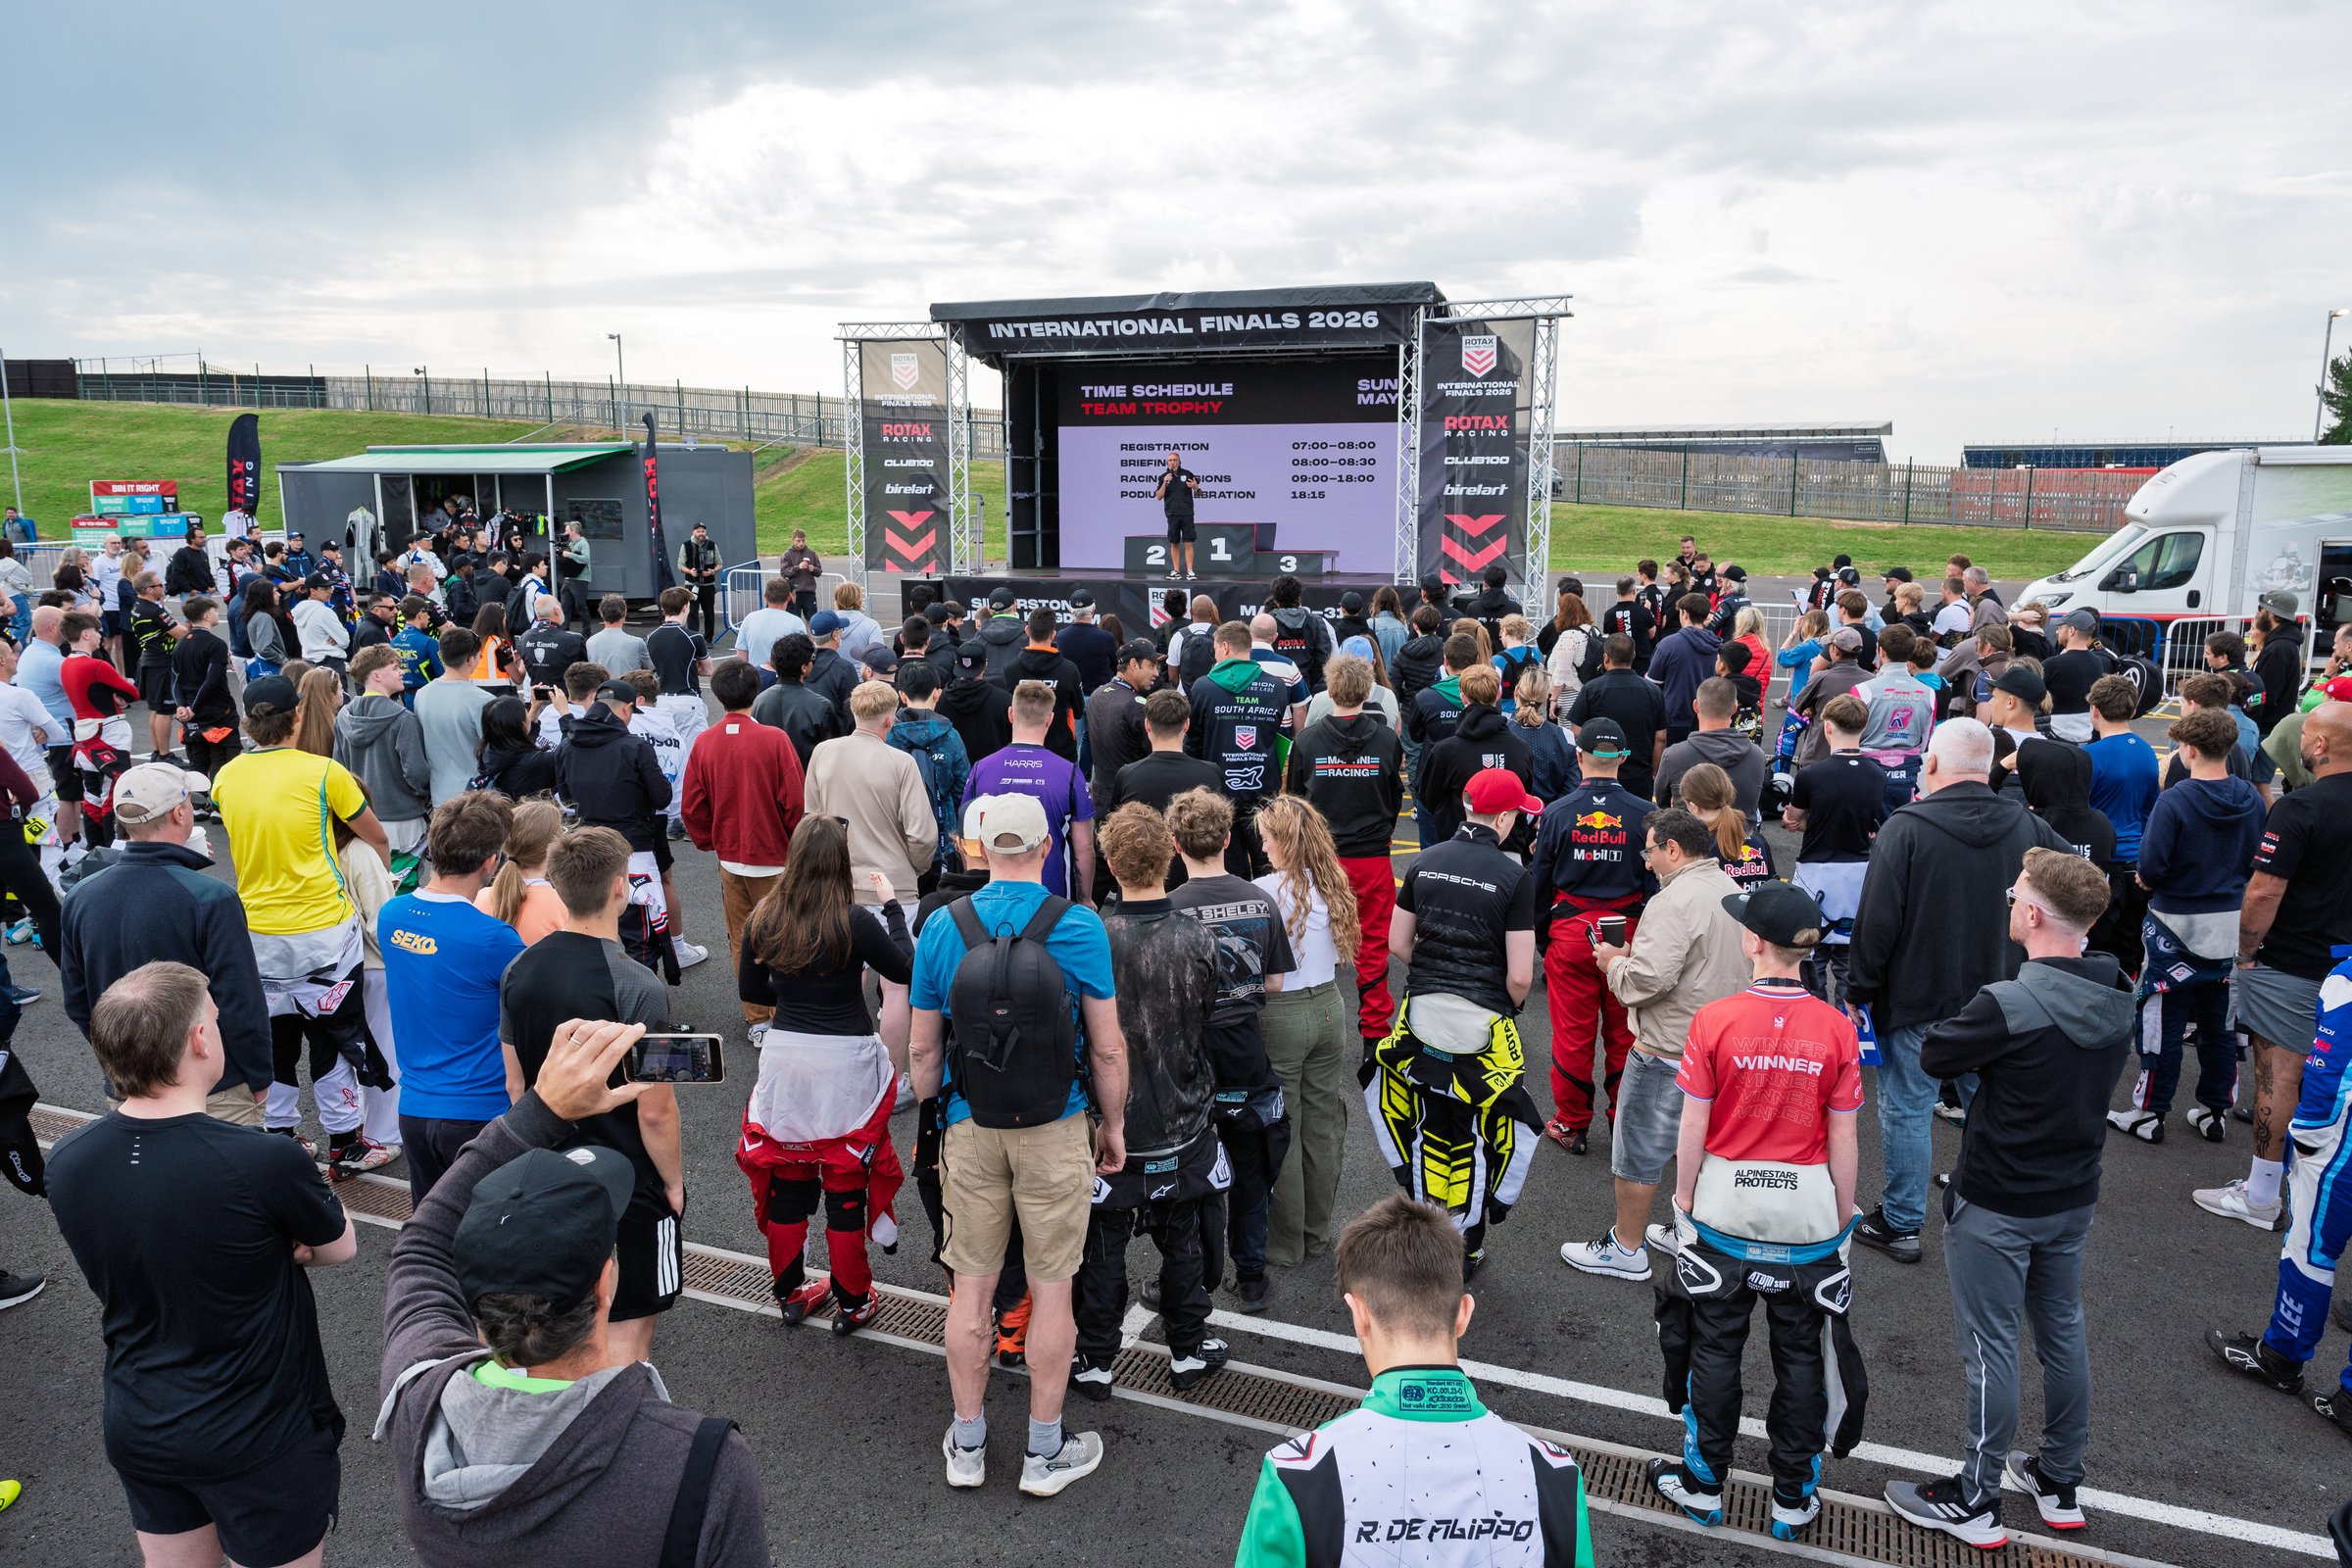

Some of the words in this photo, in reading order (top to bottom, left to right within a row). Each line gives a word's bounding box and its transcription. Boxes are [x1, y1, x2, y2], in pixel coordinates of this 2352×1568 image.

[988, 318, 1194, 338] INTERNATIONAL
[1200, 312, 1300, 333] FINALS
[1308, 311, 1380, 328] 2026
[1081, 385, 1127, 398] TIME
[1132, 383, 1234, 397] SCHEDULE
[1437, 380, 1520, 390] INTERNATIONAL
[1357, 392, 1398, 405] MAY
[1081, 402, 1137, 416] TEAM
[1142, 401, 1223, 416] TROPHY
[1445, 415, 1509, 430] ROTAX
[882, 423, 931, 436] ROTAX
[1120, 443, 1209, 452] REGISTRATION
[884, 459, 934, 467] CLUB100
[1120, 459, 1167, 467] BRIEFIN
[1444, 456, 1510, 466] CLUB100
[232, 458, 245, 506] TAX
[1120, 474, 1160, 483] RACIN
[1195, 474, 1232, 483] SIONS
[112, 484, 126, 493] BIN
[885, 483, 934, 495] birelart
[1443, 483, 1508, 496] birelart
[1146, 545, 1165, 565] 2
[1210, 537, 1232, 562] 1
[1279, 556, 1298, 572] 3
[970, 598, 1071, 611] SIRSTON
[1623, 611, 1632, 637] STAF
[1214, 706, 1245, 714] SOUTH
[1004, 760, 1043, 769] HARRIS
[1328, 756, 1370, 764] MAINI
[1328, 768, 1370, 777] RACING
[1571, 829, 1599, 844] Red
[1599, 830, 1627, 845] Bull
[1573, 849, 1607, 861] Mobil
[1610, 851, 1621, 862] 1
[1724, 863, 1749, 877] Red
[1418, 870, 1496, 893] PORSCHE
[1201, 903, 1267, 920] SHELBY
[390, 929, 437, 953] SEKO
[1229, 985, 1265, 998] COBRA
[1732, 1037, 1828, 1059] WINNER
[1732, 1054, 1824, 1077] WINNER
[1734, 1071, 1819, 1095] WINNER
[1734, 1169, 1798, 1180] ALPINESTARS
[1734, 1178, 1798, 1191] PROTECTS
[1774, 1280, 1790, 1290] SUIT
[2276, 1289, 2304, 1339] LEE
[1355, 1520, 1381, 1544] R.
[1386, 1518, 1427, 1544] DE
